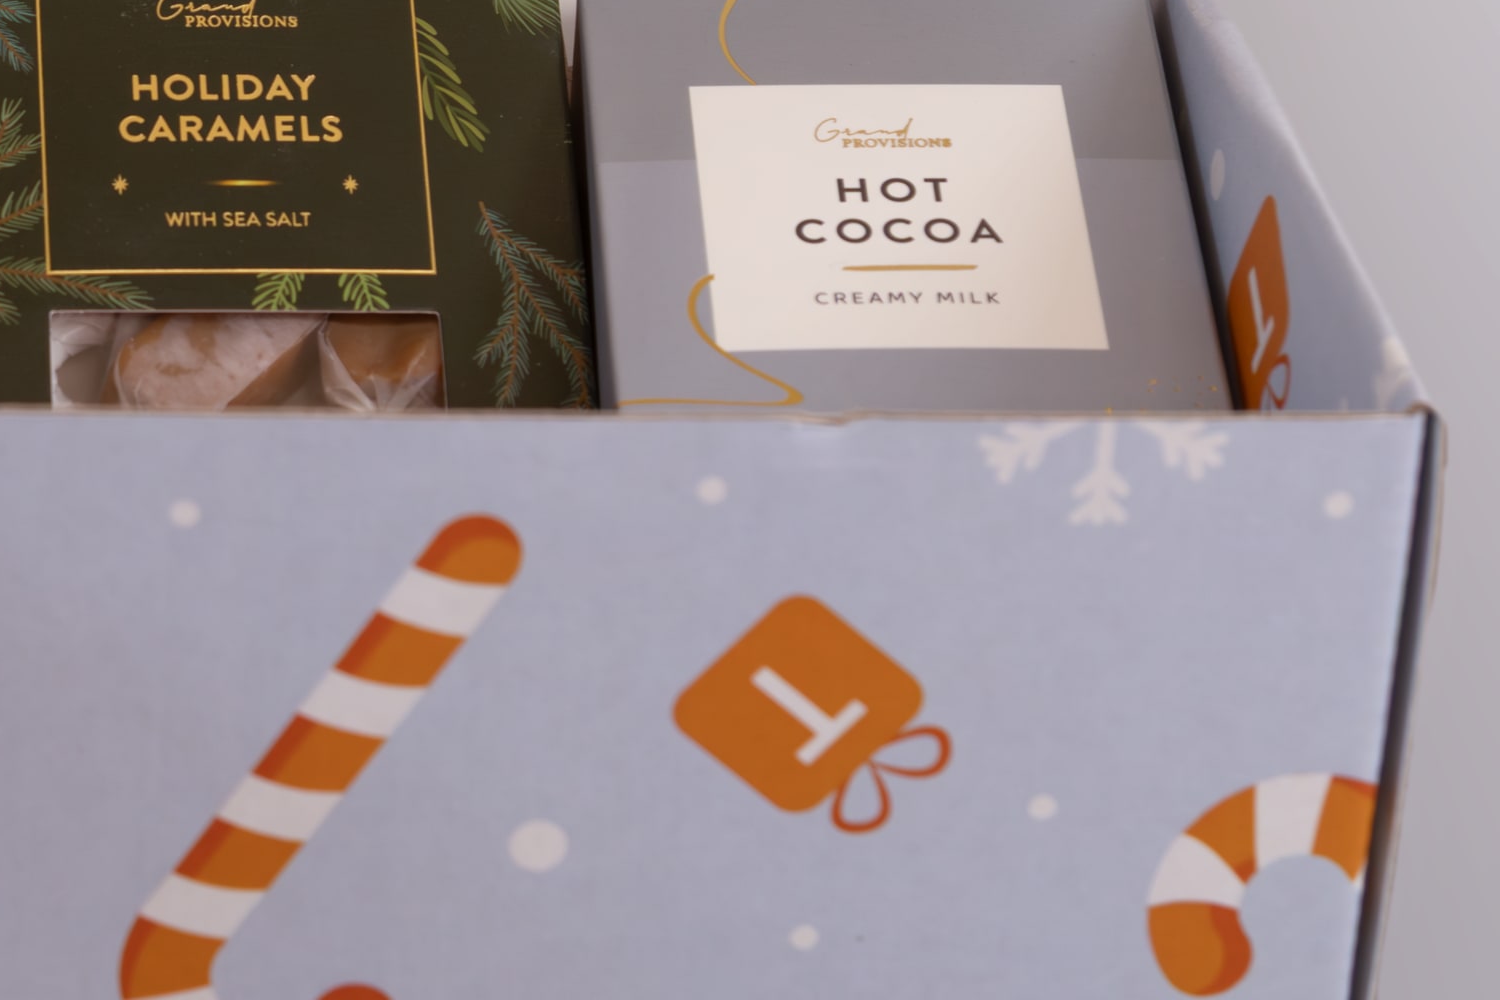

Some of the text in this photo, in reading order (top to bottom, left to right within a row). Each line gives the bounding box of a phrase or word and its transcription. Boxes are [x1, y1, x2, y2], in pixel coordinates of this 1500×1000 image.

[184, 14, 299, 28] PROVISIONS
[131, 73, 317, 101] HOLIDAY
[118, 114, 344, 143] CARAMELS
[814, 117, 912, 143] Grand
[841, 137, 953, 149] PROVISIONS
[835, 177, 949, 203] HOT
[164, 210, 312, 228] WITH SEA SALT
[794, 217, 1004, 245] COCOA
[814, 291, 1001, 306] CREAMY MILK
